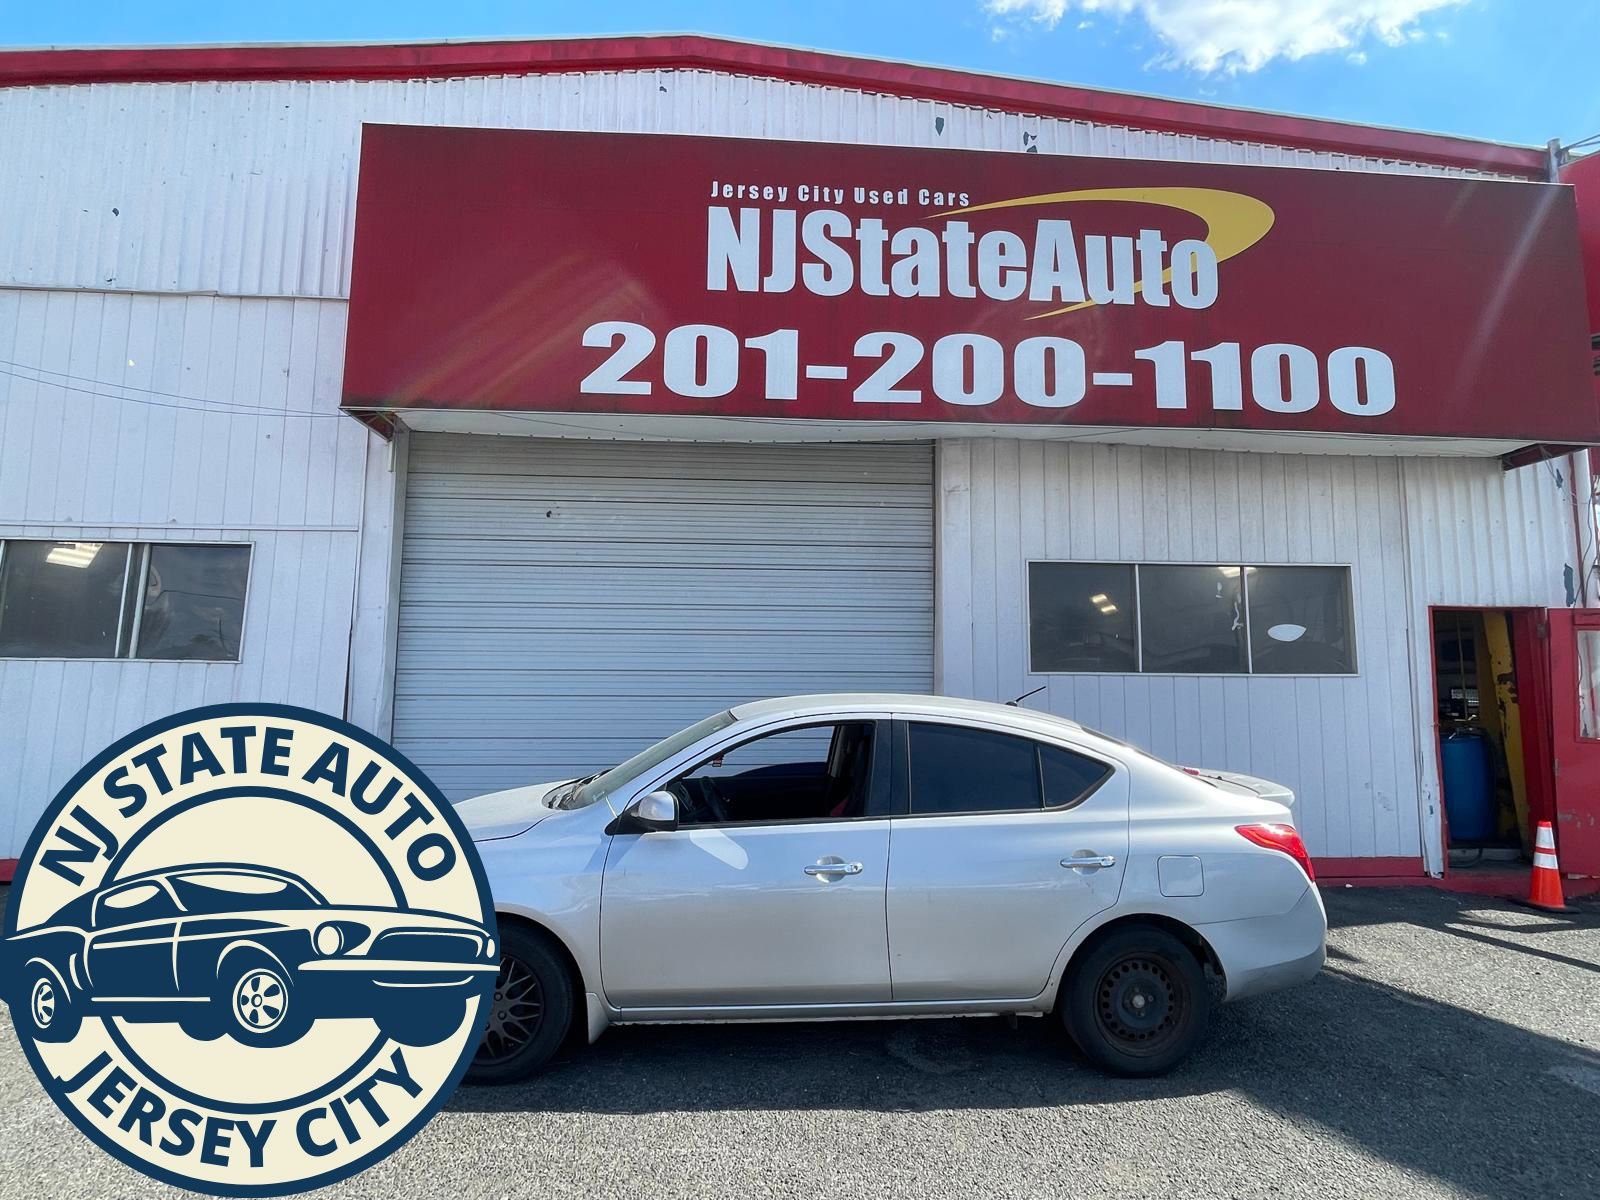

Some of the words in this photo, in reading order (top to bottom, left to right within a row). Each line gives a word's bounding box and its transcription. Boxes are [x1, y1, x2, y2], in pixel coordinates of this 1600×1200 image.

[710, 181, 788, 202] Jersey
[797, 184, 844, 204] City
[854, 187, 908, 205] Used
[918, 188, 969, 206] Cars
[707, 207, 1218, 309] NJStateAuto
[580, 322, 1396, 416] 201-200-1100
